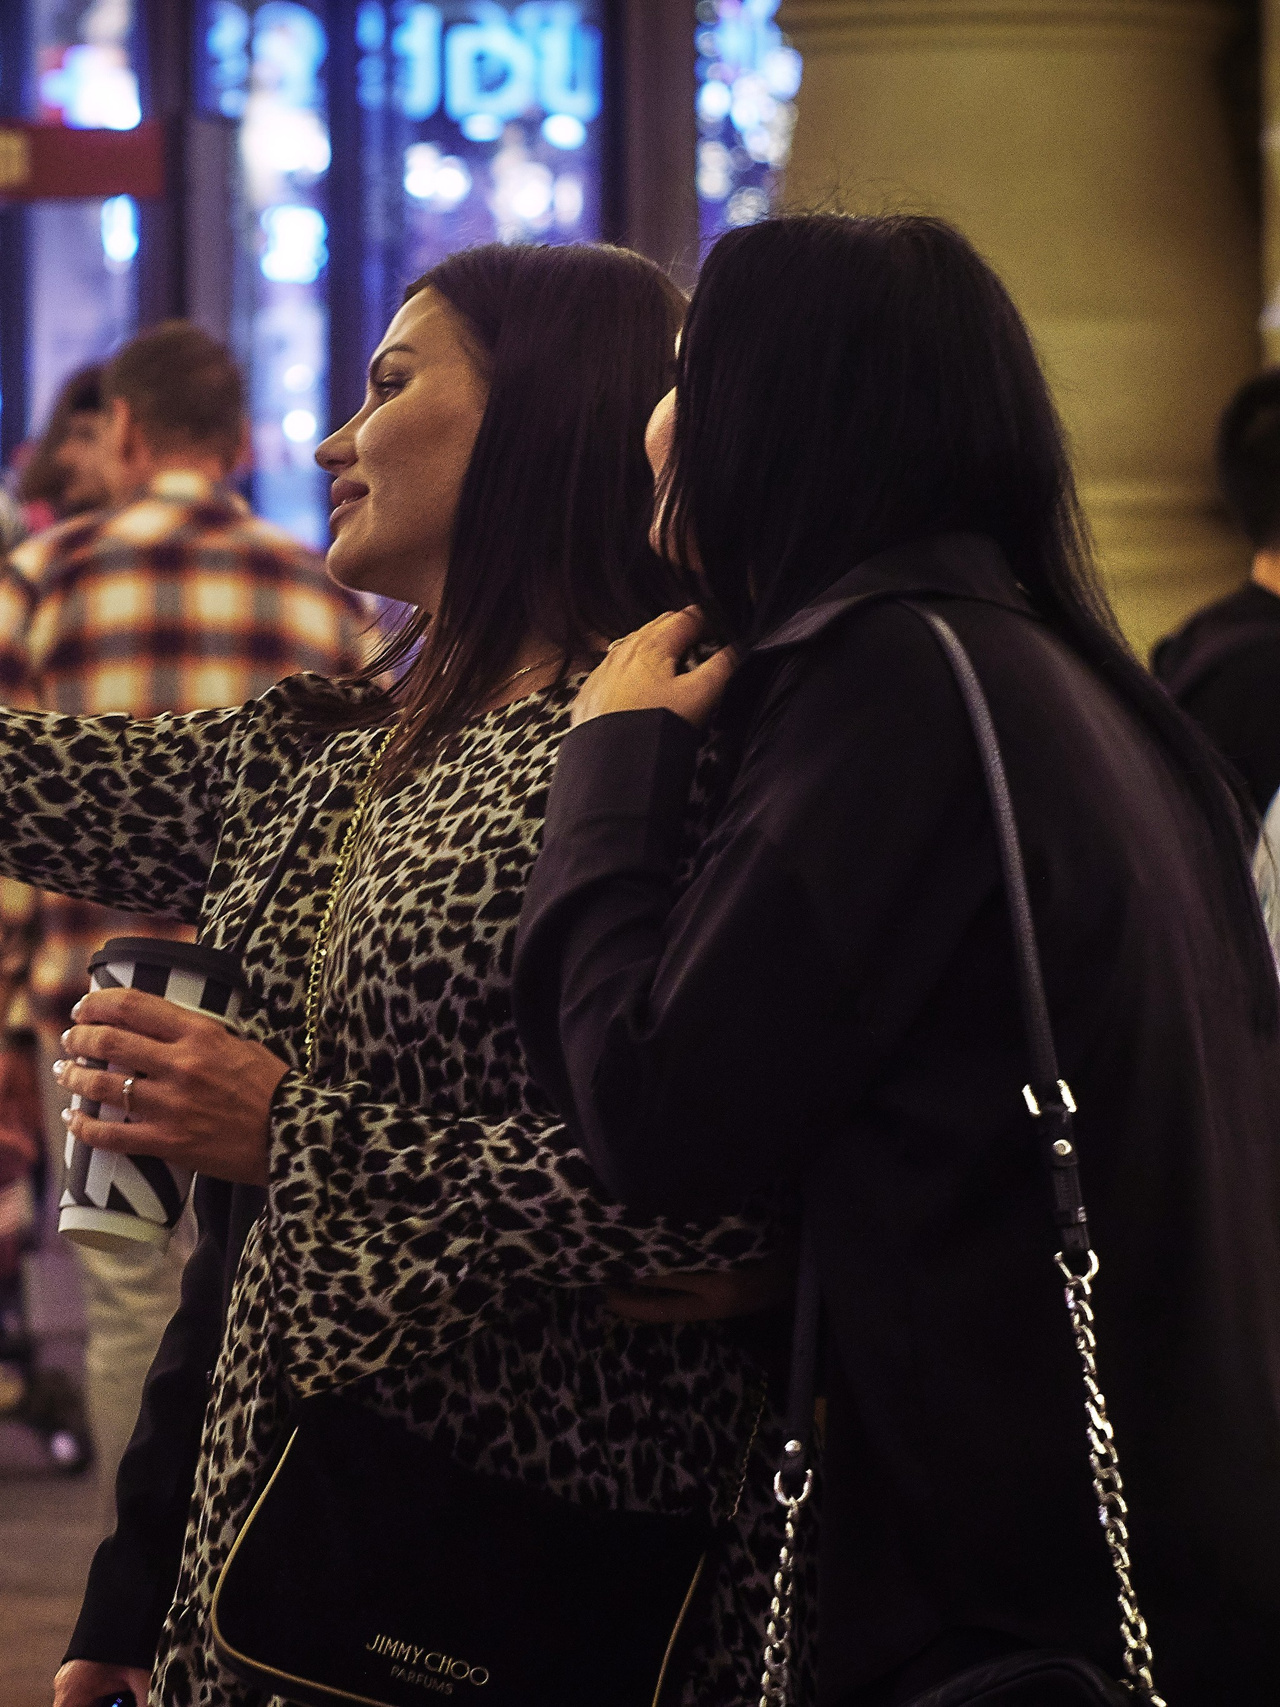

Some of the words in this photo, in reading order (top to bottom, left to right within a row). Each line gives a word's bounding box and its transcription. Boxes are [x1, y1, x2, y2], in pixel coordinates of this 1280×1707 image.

[366, 1633, 424, 1665] JIMMY
[424, 1652, 490, 1686] CHOO
[389, 1664, 454, 1695] PARFUMS
